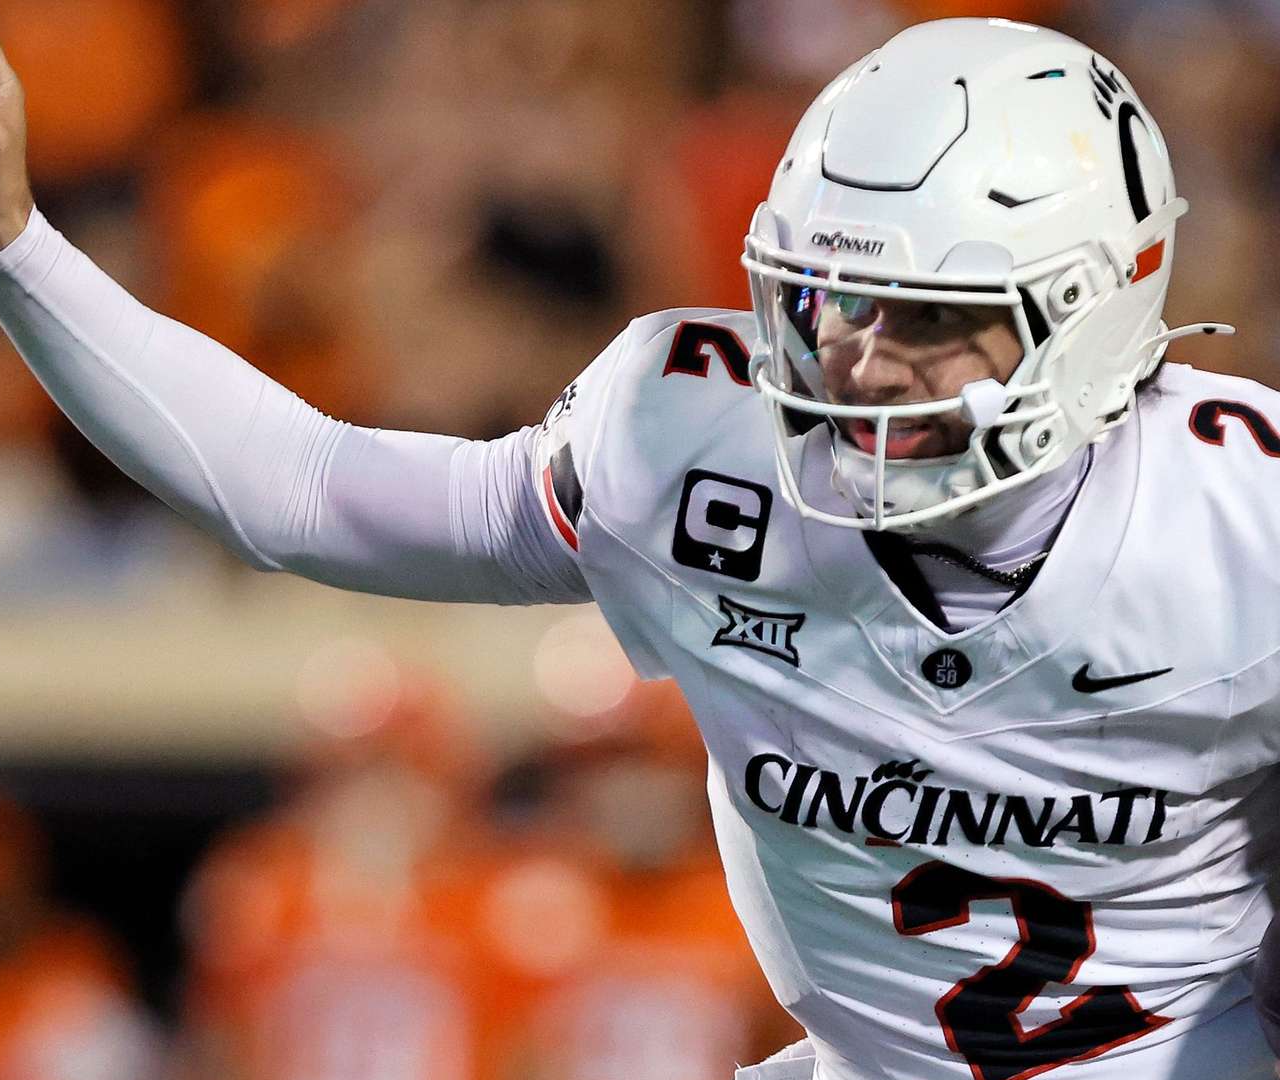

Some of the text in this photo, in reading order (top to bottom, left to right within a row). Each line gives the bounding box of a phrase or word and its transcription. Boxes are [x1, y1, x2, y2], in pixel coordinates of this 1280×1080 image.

[811, 231, 885, 257] CINCINNATI
[685, 478, 762, 552] C
[722, 601, 798, 660] XII
[935, 654, 957, 668] JK
[745, 752, 1169, 848] CINCINNATI
